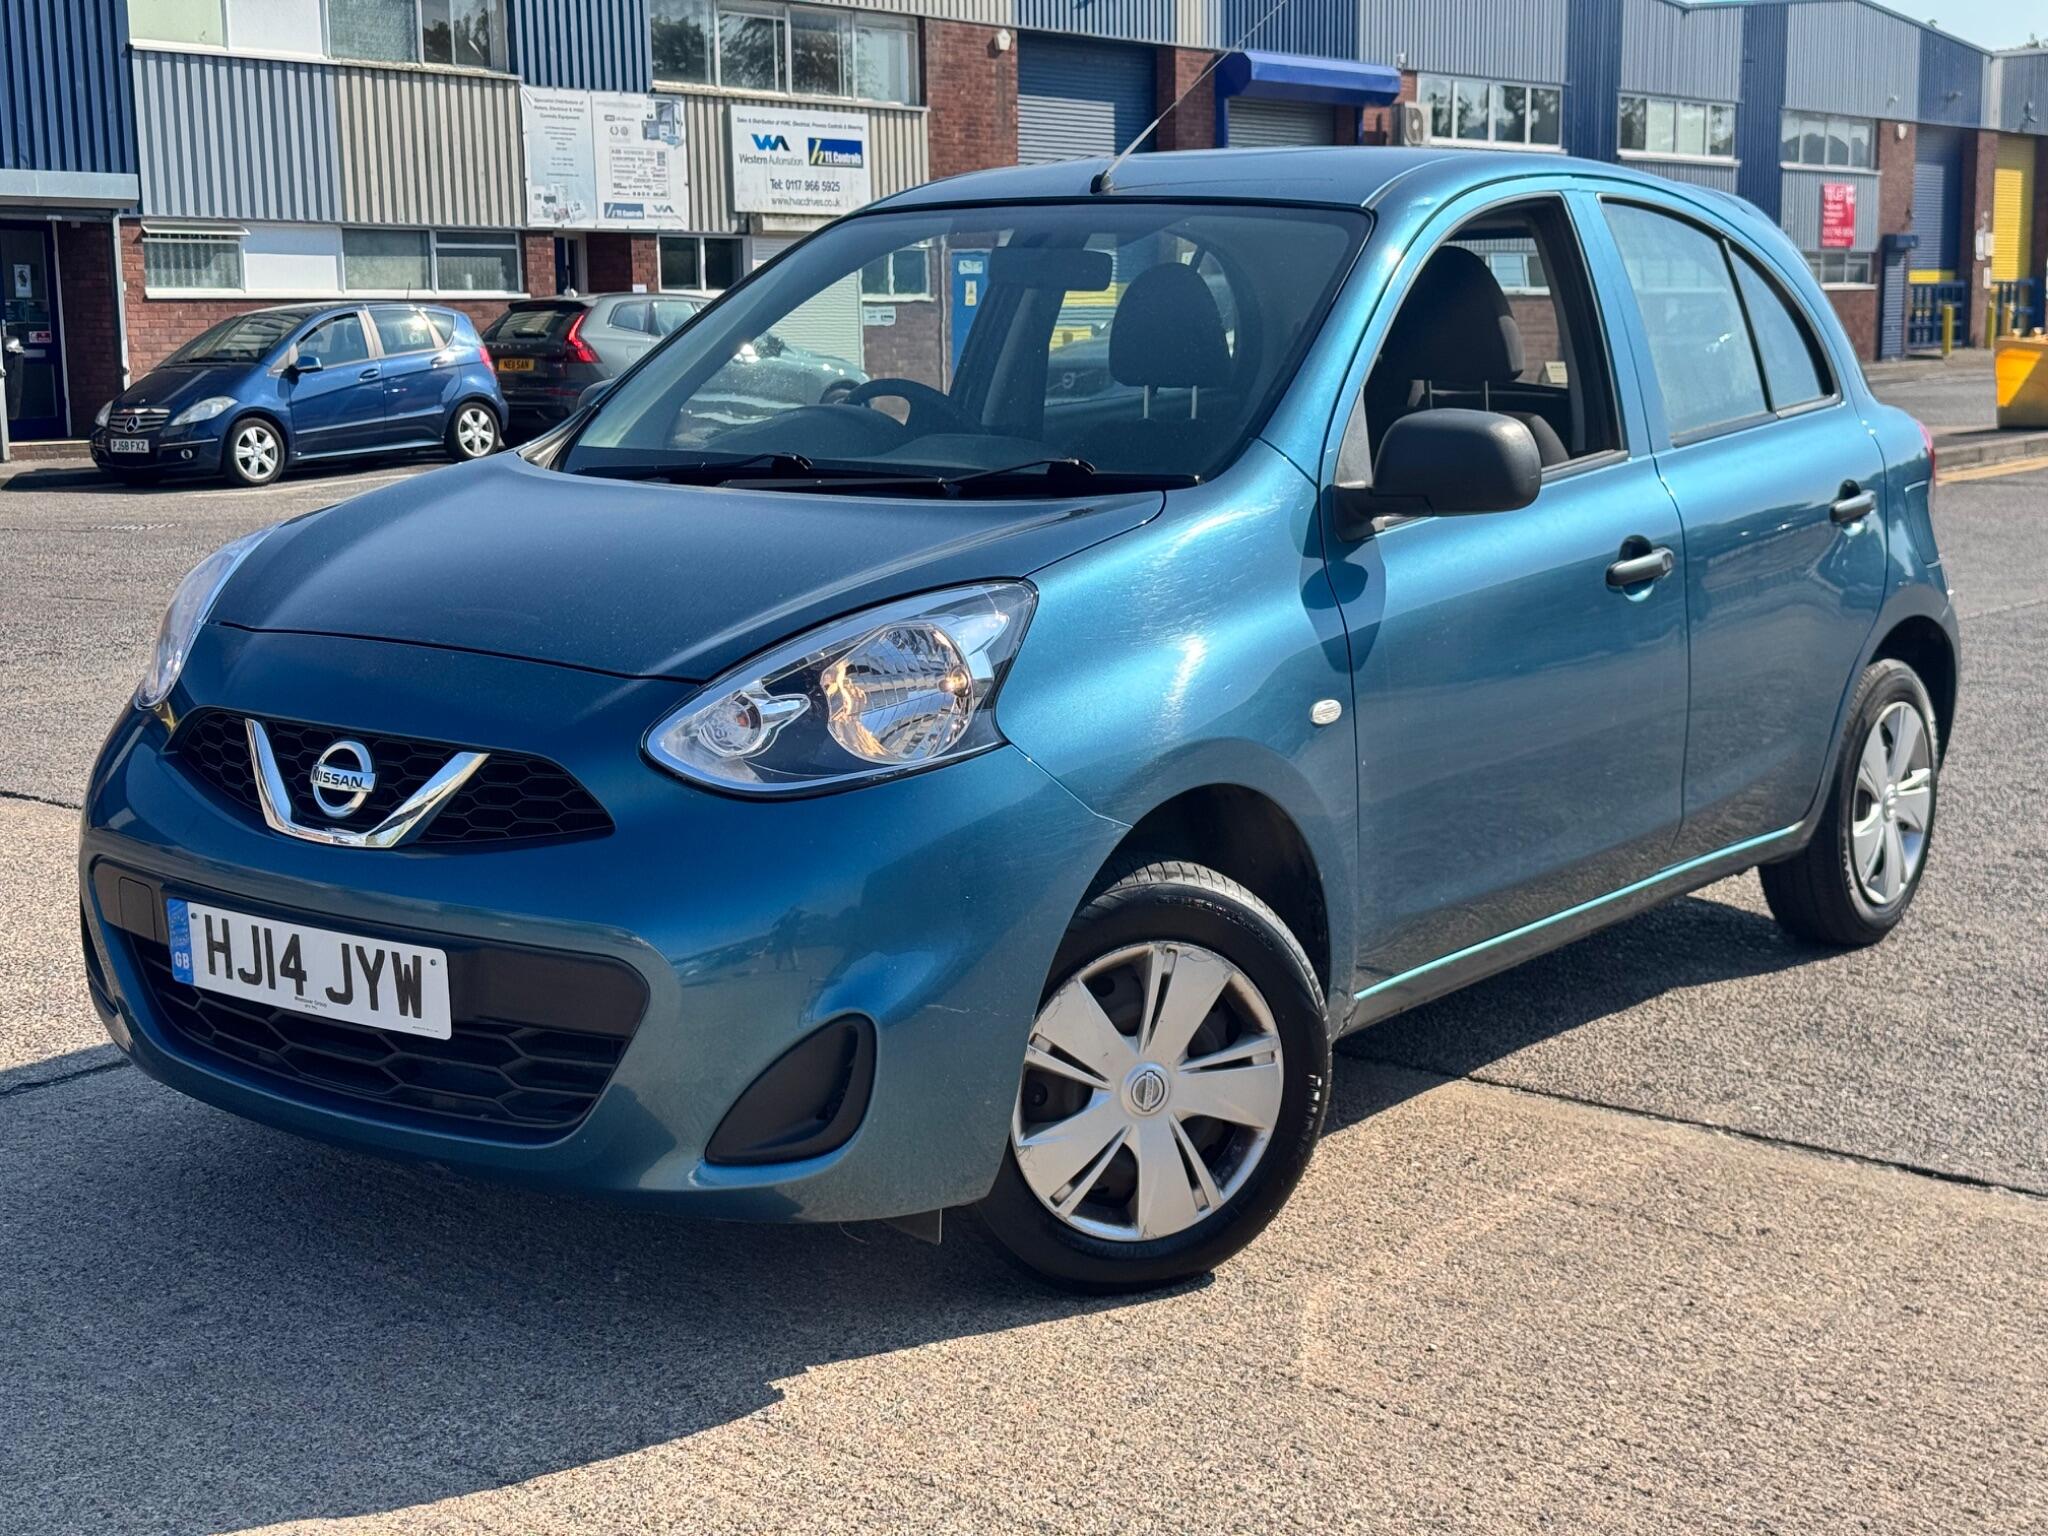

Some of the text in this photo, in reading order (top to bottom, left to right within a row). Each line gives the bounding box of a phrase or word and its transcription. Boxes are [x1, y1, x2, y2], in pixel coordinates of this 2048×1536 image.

[739, 153, 804, 166] Western Automation
[785, 179, 802, 190] 0117
[804, 180, 820, 191] 966
[822, 181, 840, 192] 5925
[130, 440, 146, 451] FXZ
[312, 767, 363, 788] NISSAN
[175, 951, 189, 969] GB
[204, 914, 422, 1019] HJ14 JYW
